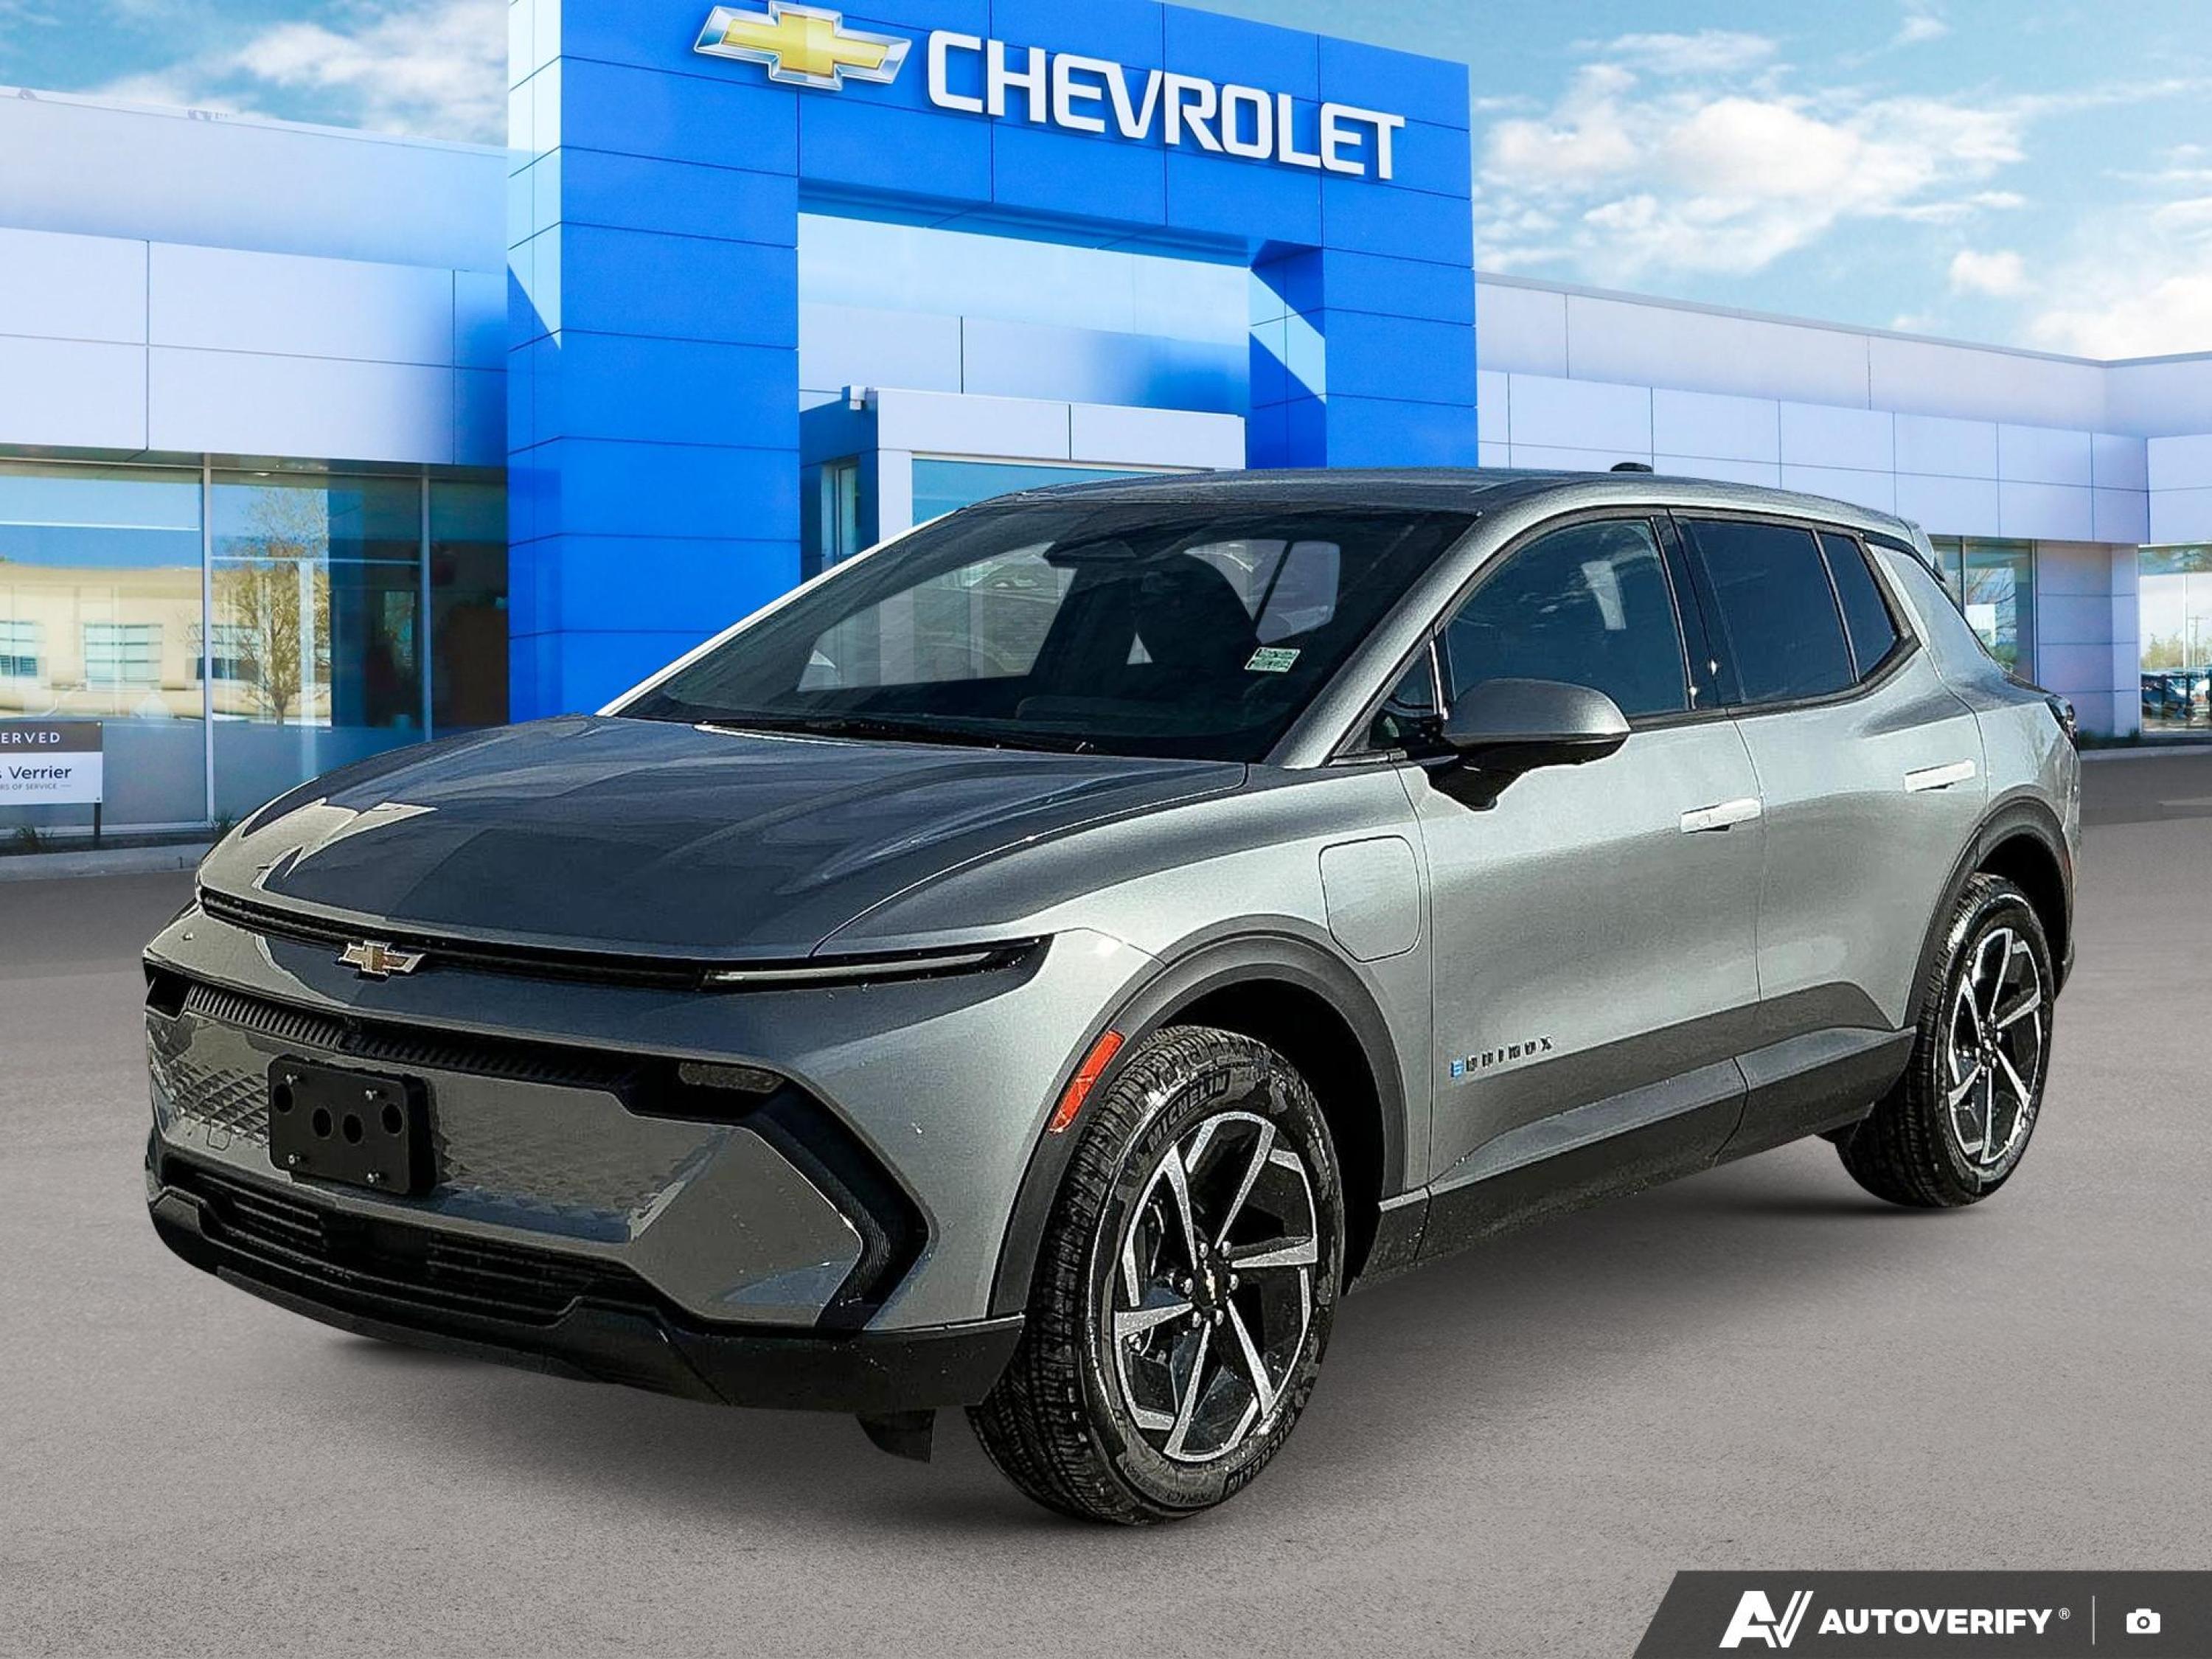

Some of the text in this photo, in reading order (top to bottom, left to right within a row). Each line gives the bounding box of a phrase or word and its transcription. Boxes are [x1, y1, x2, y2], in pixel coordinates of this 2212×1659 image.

[928, 29, 1405, 180] CHEVROLET
[1, 732, 60, 744] ERVED
[8, 765, 72, 779] Verrier
[1147, 1073, 1228, 1152] MICHELIN
